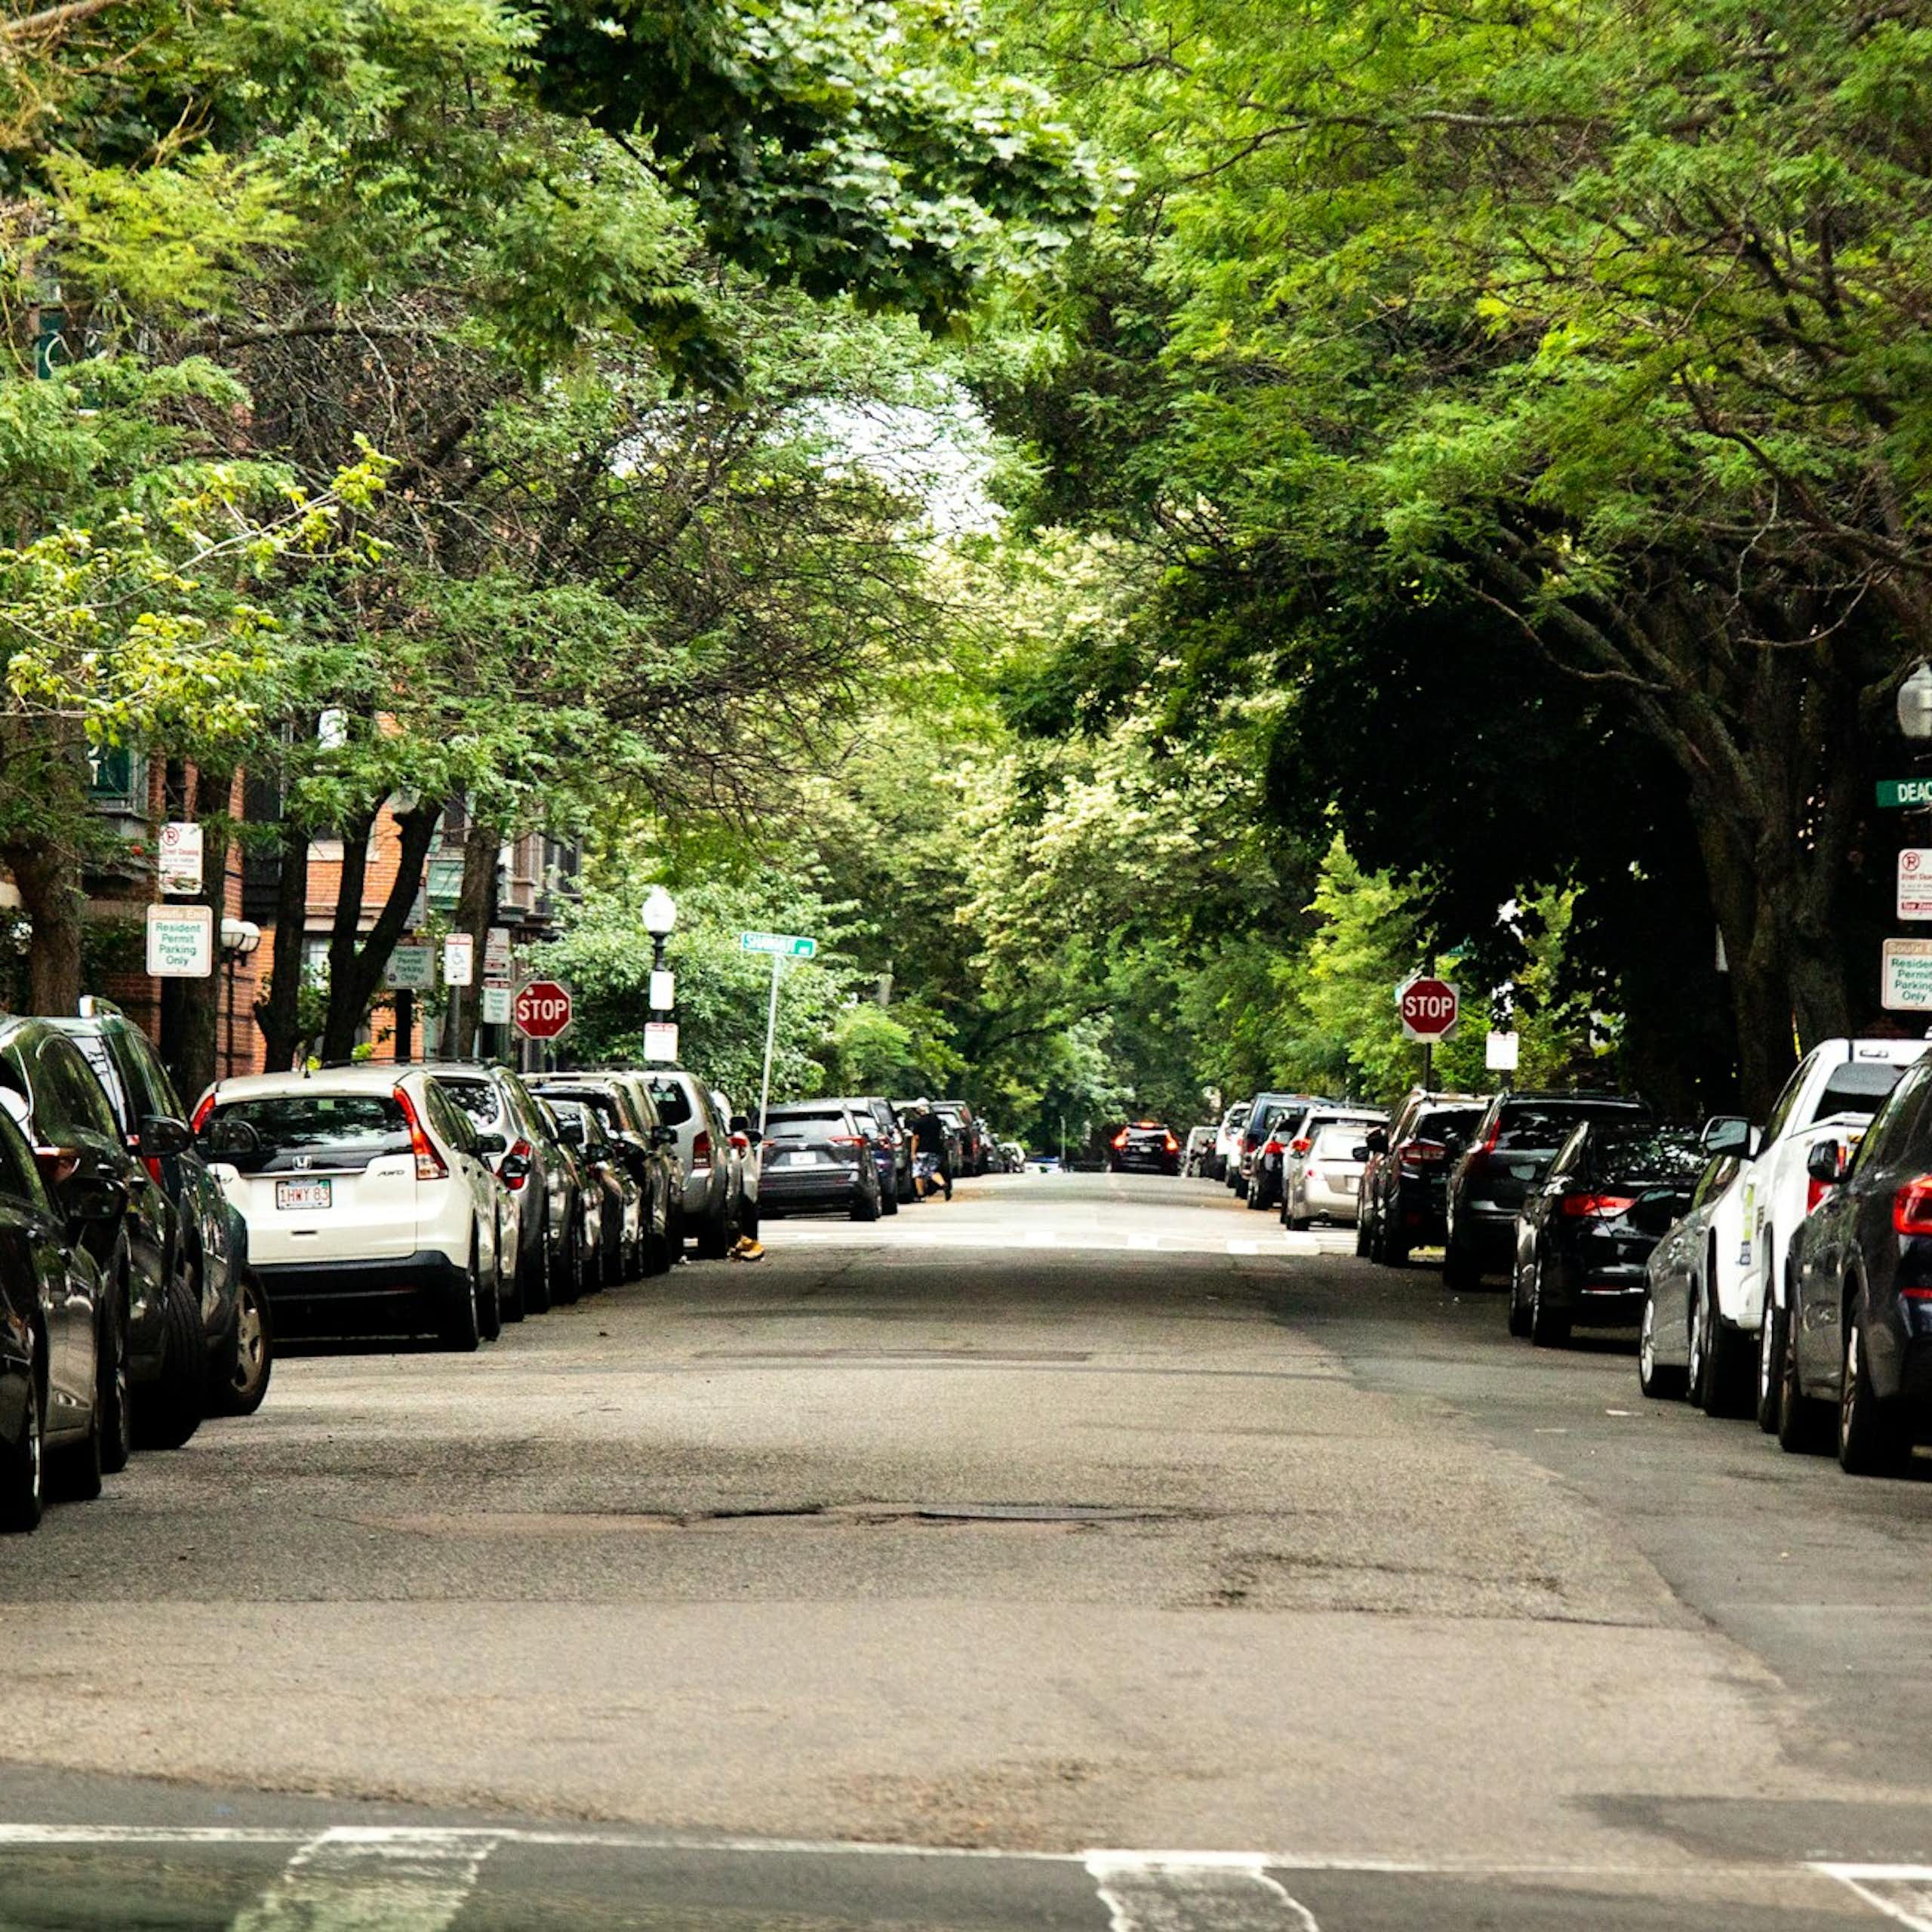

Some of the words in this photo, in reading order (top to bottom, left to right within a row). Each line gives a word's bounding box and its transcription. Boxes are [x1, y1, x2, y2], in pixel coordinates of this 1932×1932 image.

[155, 922, 202, 933] Resident
[162, 934, 194, 943] Permit
[159, 944, 197, 956] Parking
[166, 955, 189, 966] Only
[1903, 990, 1926, 1002] Only
[518, 999, 567, 1021] STOP
[1404, 996, 1453, 1017] STOP
[281, 1189, 309, 1201] 1HWY
